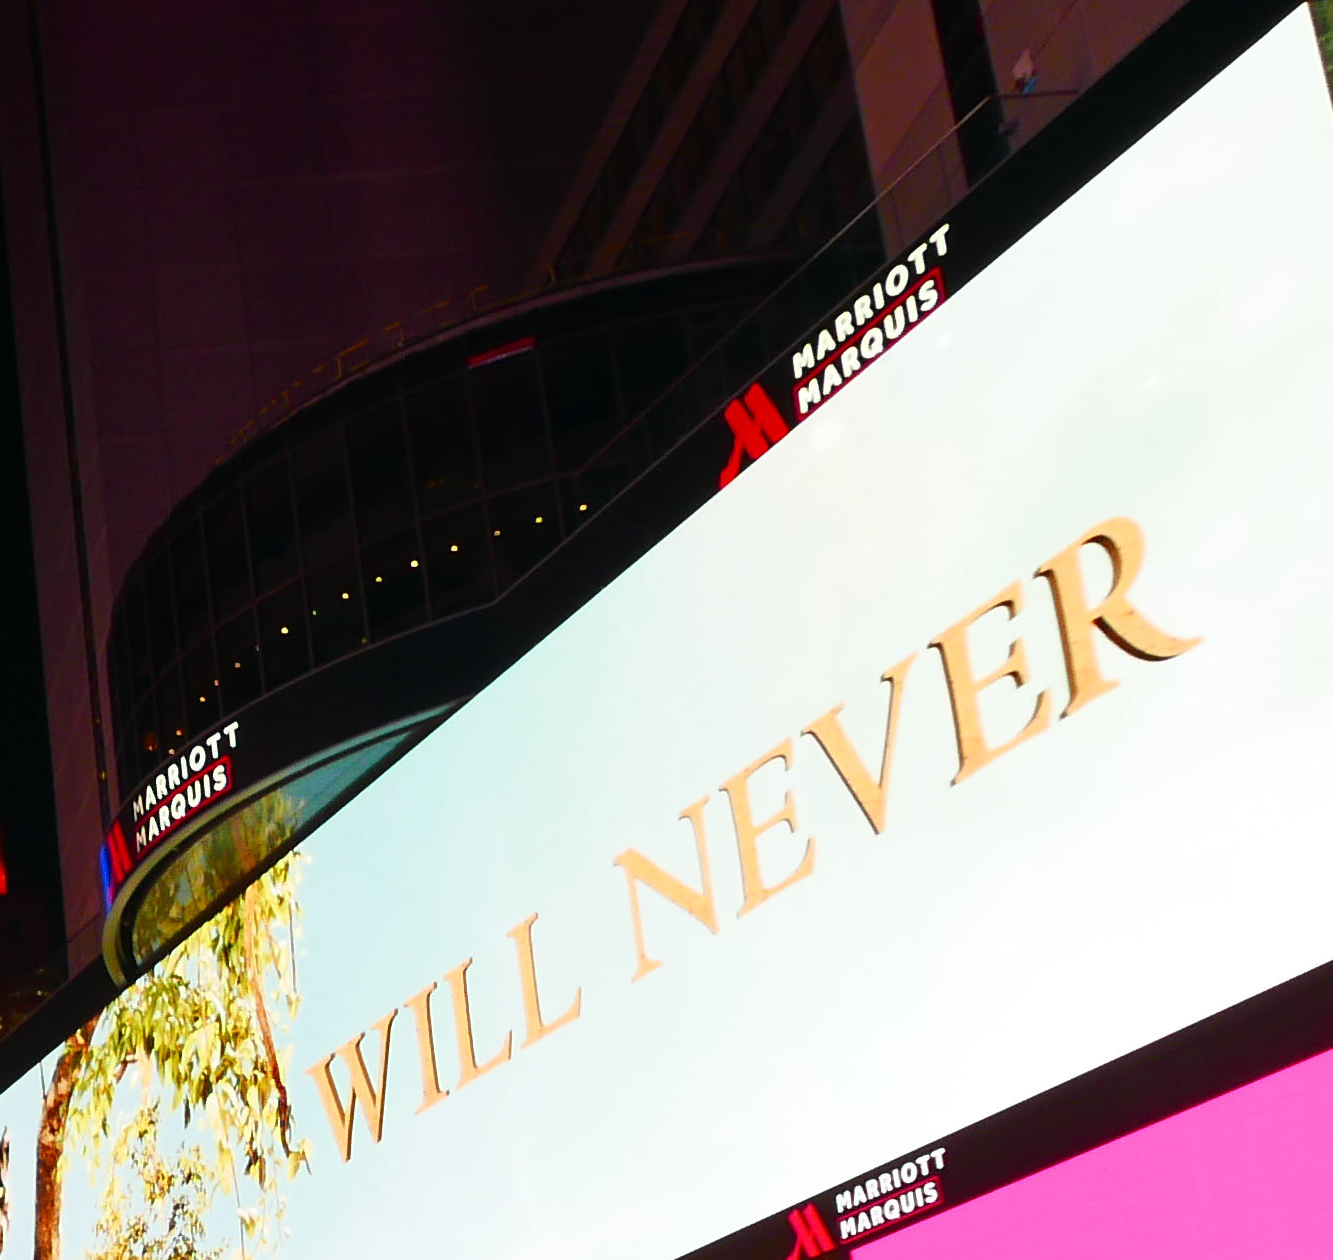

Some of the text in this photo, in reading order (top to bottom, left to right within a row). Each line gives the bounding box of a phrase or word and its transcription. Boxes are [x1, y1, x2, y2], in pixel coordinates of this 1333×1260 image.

[792, 223, 950, 379] MARRIOTT
[797, 278, 939, 415] MARQUIS
[133, 721, 239, 822] MARRIOTT
[136, 764, 228, 853] MARQUIS
[304, 516, 1204, 1163] WILL NEVER
[835, 1147, 947, 1214] MARRIOTT
[840, 1182, 939, 1240] MARQUIS
